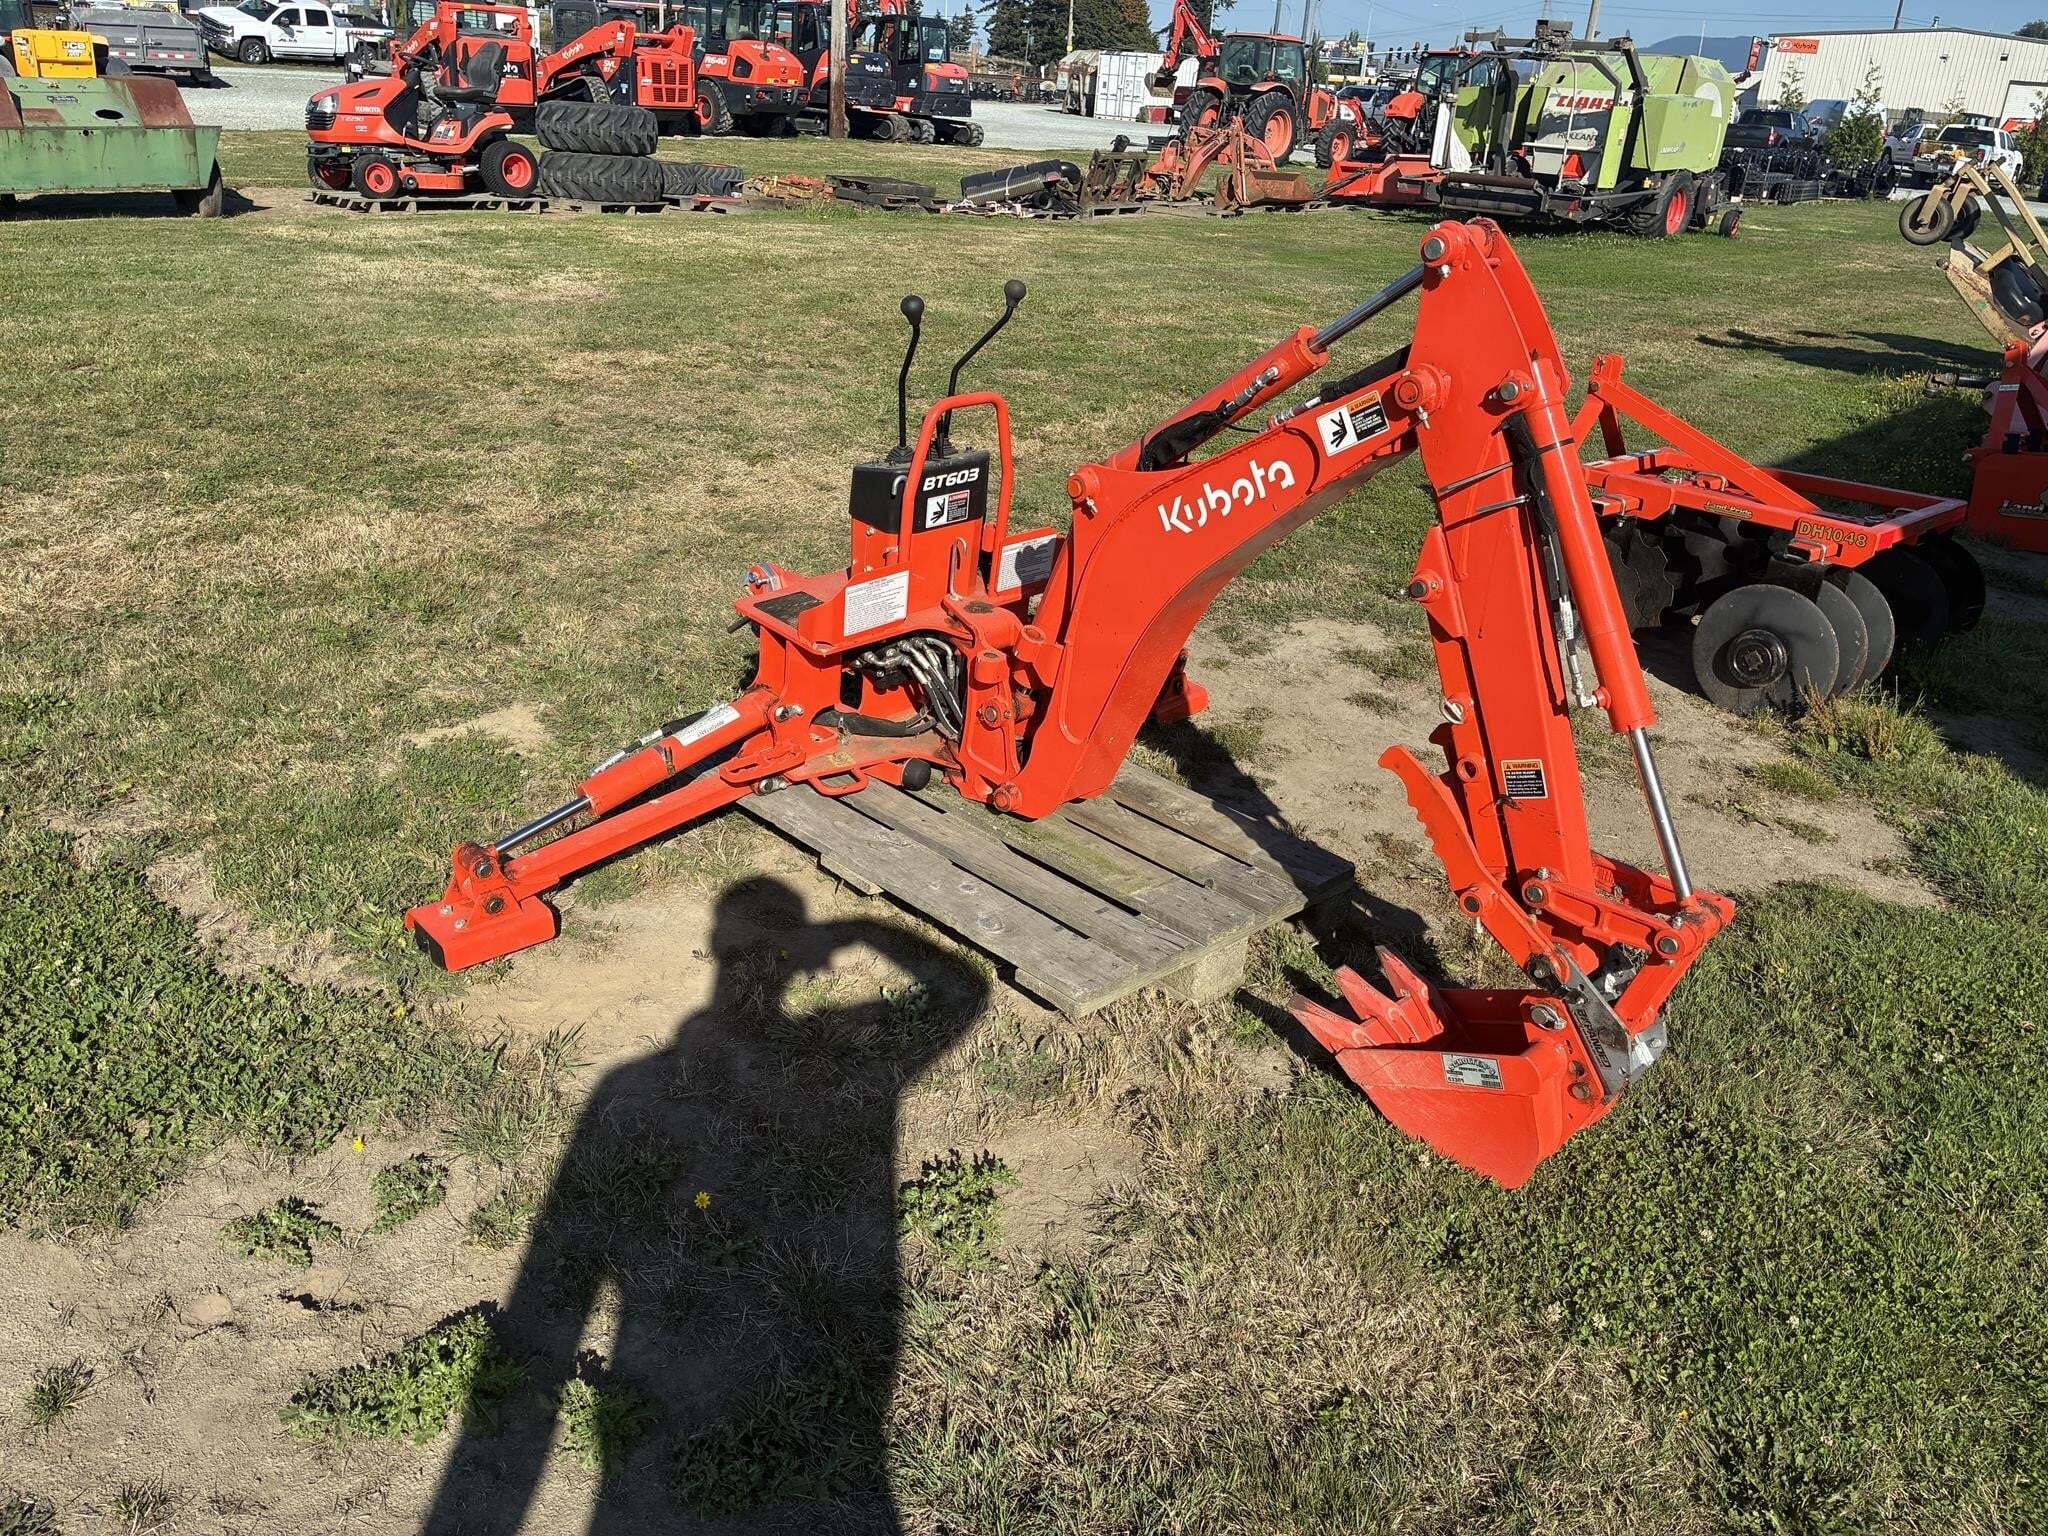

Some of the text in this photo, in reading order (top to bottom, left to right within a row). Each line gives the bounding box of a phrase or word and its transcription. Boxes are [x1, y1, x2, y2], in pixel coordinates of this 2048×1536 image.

[62, 41, 86, 50] JCB
[561, 42, 585, 60] Kubota
[1793, 42, 1817, 50] Kubota
[1556, 96, 1615, 112] CLAAS
[922, 467, 980, 492] BT603
[1158, 459, 1296, 534] Kubota
[1799, 521, 1867, 547] DH1048
